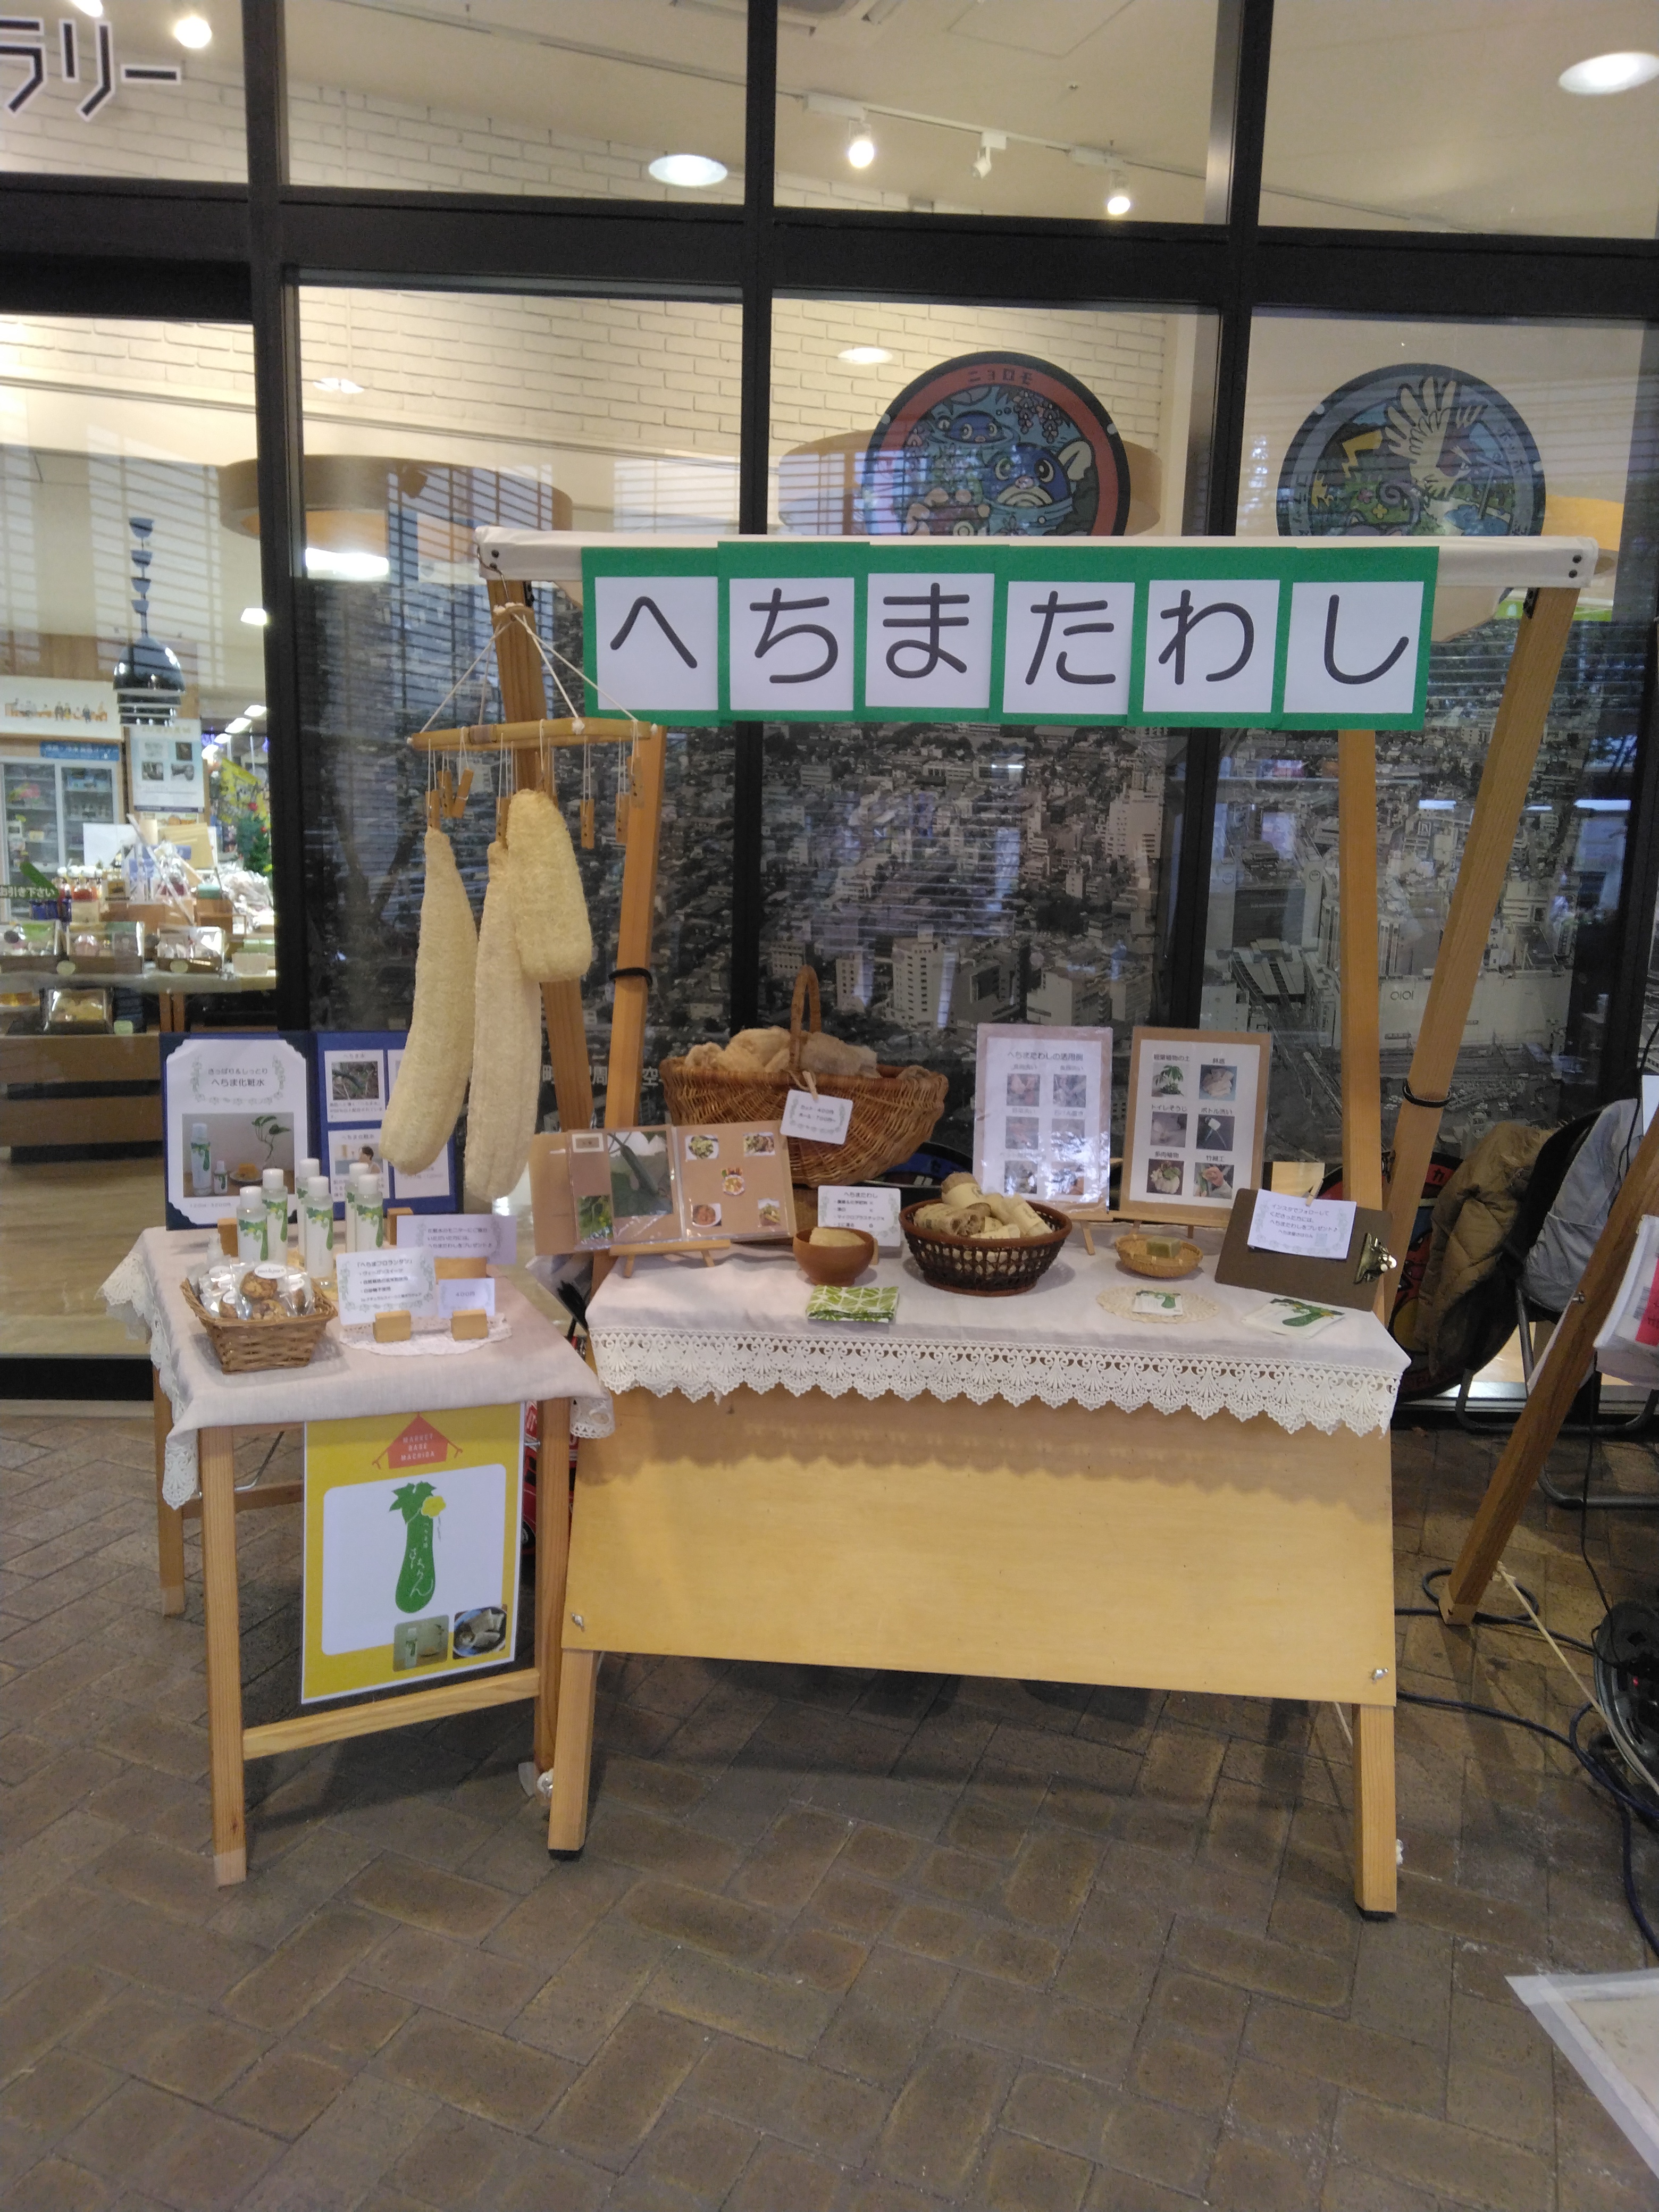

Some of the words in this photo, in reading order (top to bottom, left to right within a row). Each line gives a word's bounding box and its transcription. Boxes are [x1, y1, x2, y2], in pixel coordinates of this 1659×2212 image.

[0, 16, 182, 122] ラリー
[968, 367, 1034, 386] ニョロモ
[609, 582, 1410, 686] へちまたわし
[1007, 1051, 1084, 1061] へちまたわしの活用例
[211, 1078, 265, 1087] へちま化粧水
[1271, 1203, 1330, 1217] インスタでフォローして
[357, 1258, 413, 1268] 「へちまフロランタン」
[403, 1433, 434, 1444] MARKET
[408, 1443, 428, 1452] BASE
[400, 1451, 435, 1461] MACHIDA
